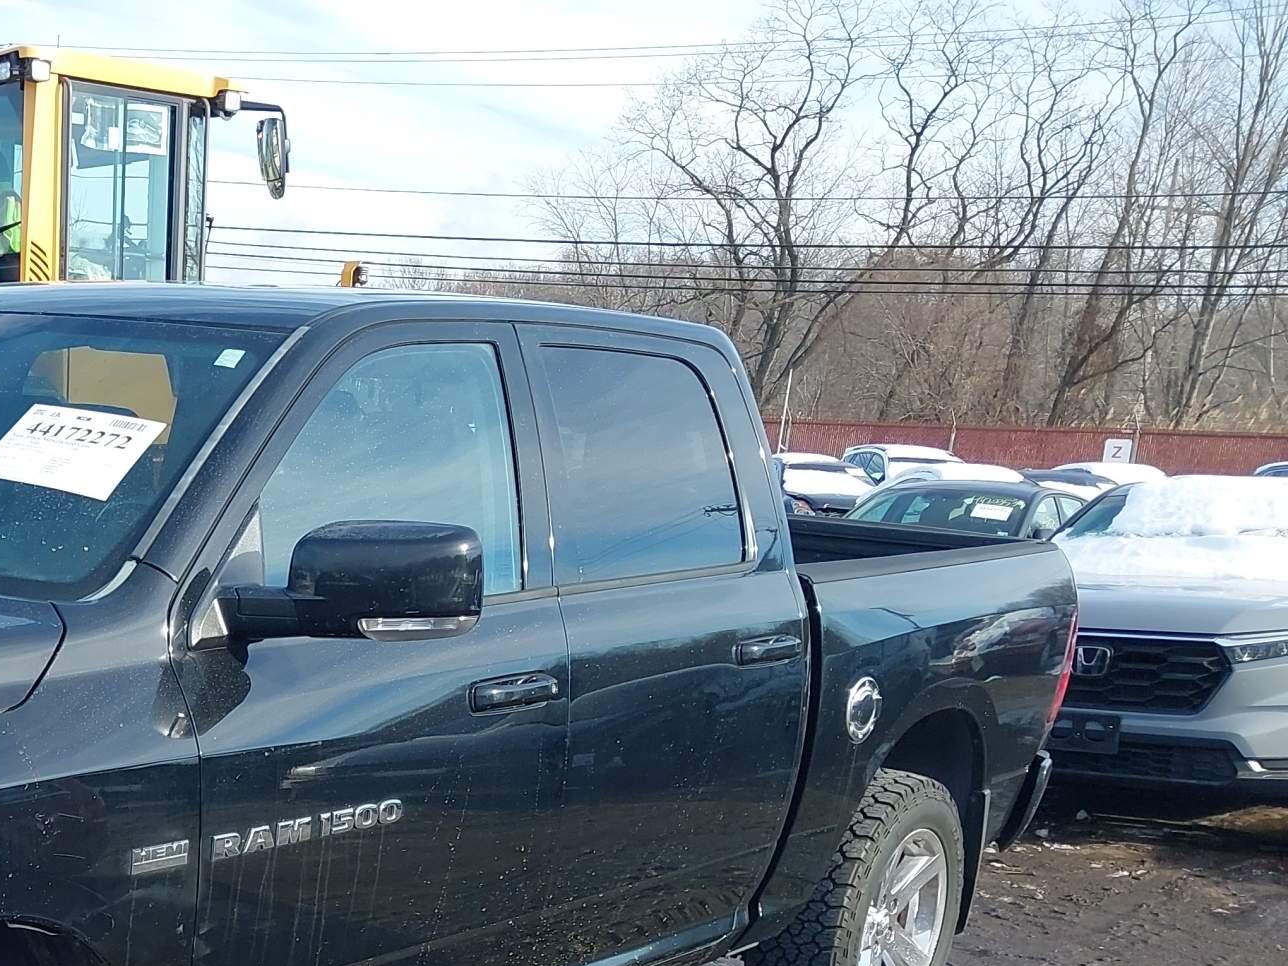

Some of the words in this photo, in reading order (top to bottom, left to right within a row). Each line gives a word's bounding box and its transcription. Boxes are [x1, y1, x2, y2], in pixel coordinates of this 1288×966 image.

[26, 421, 133, 450] 44172272
[1111, 446, 1123, 459] Z
[211, 816, 312, 862] RAM
[319, 798, 404, 837] 1500
[131, 839, 190, 866] HEMI
